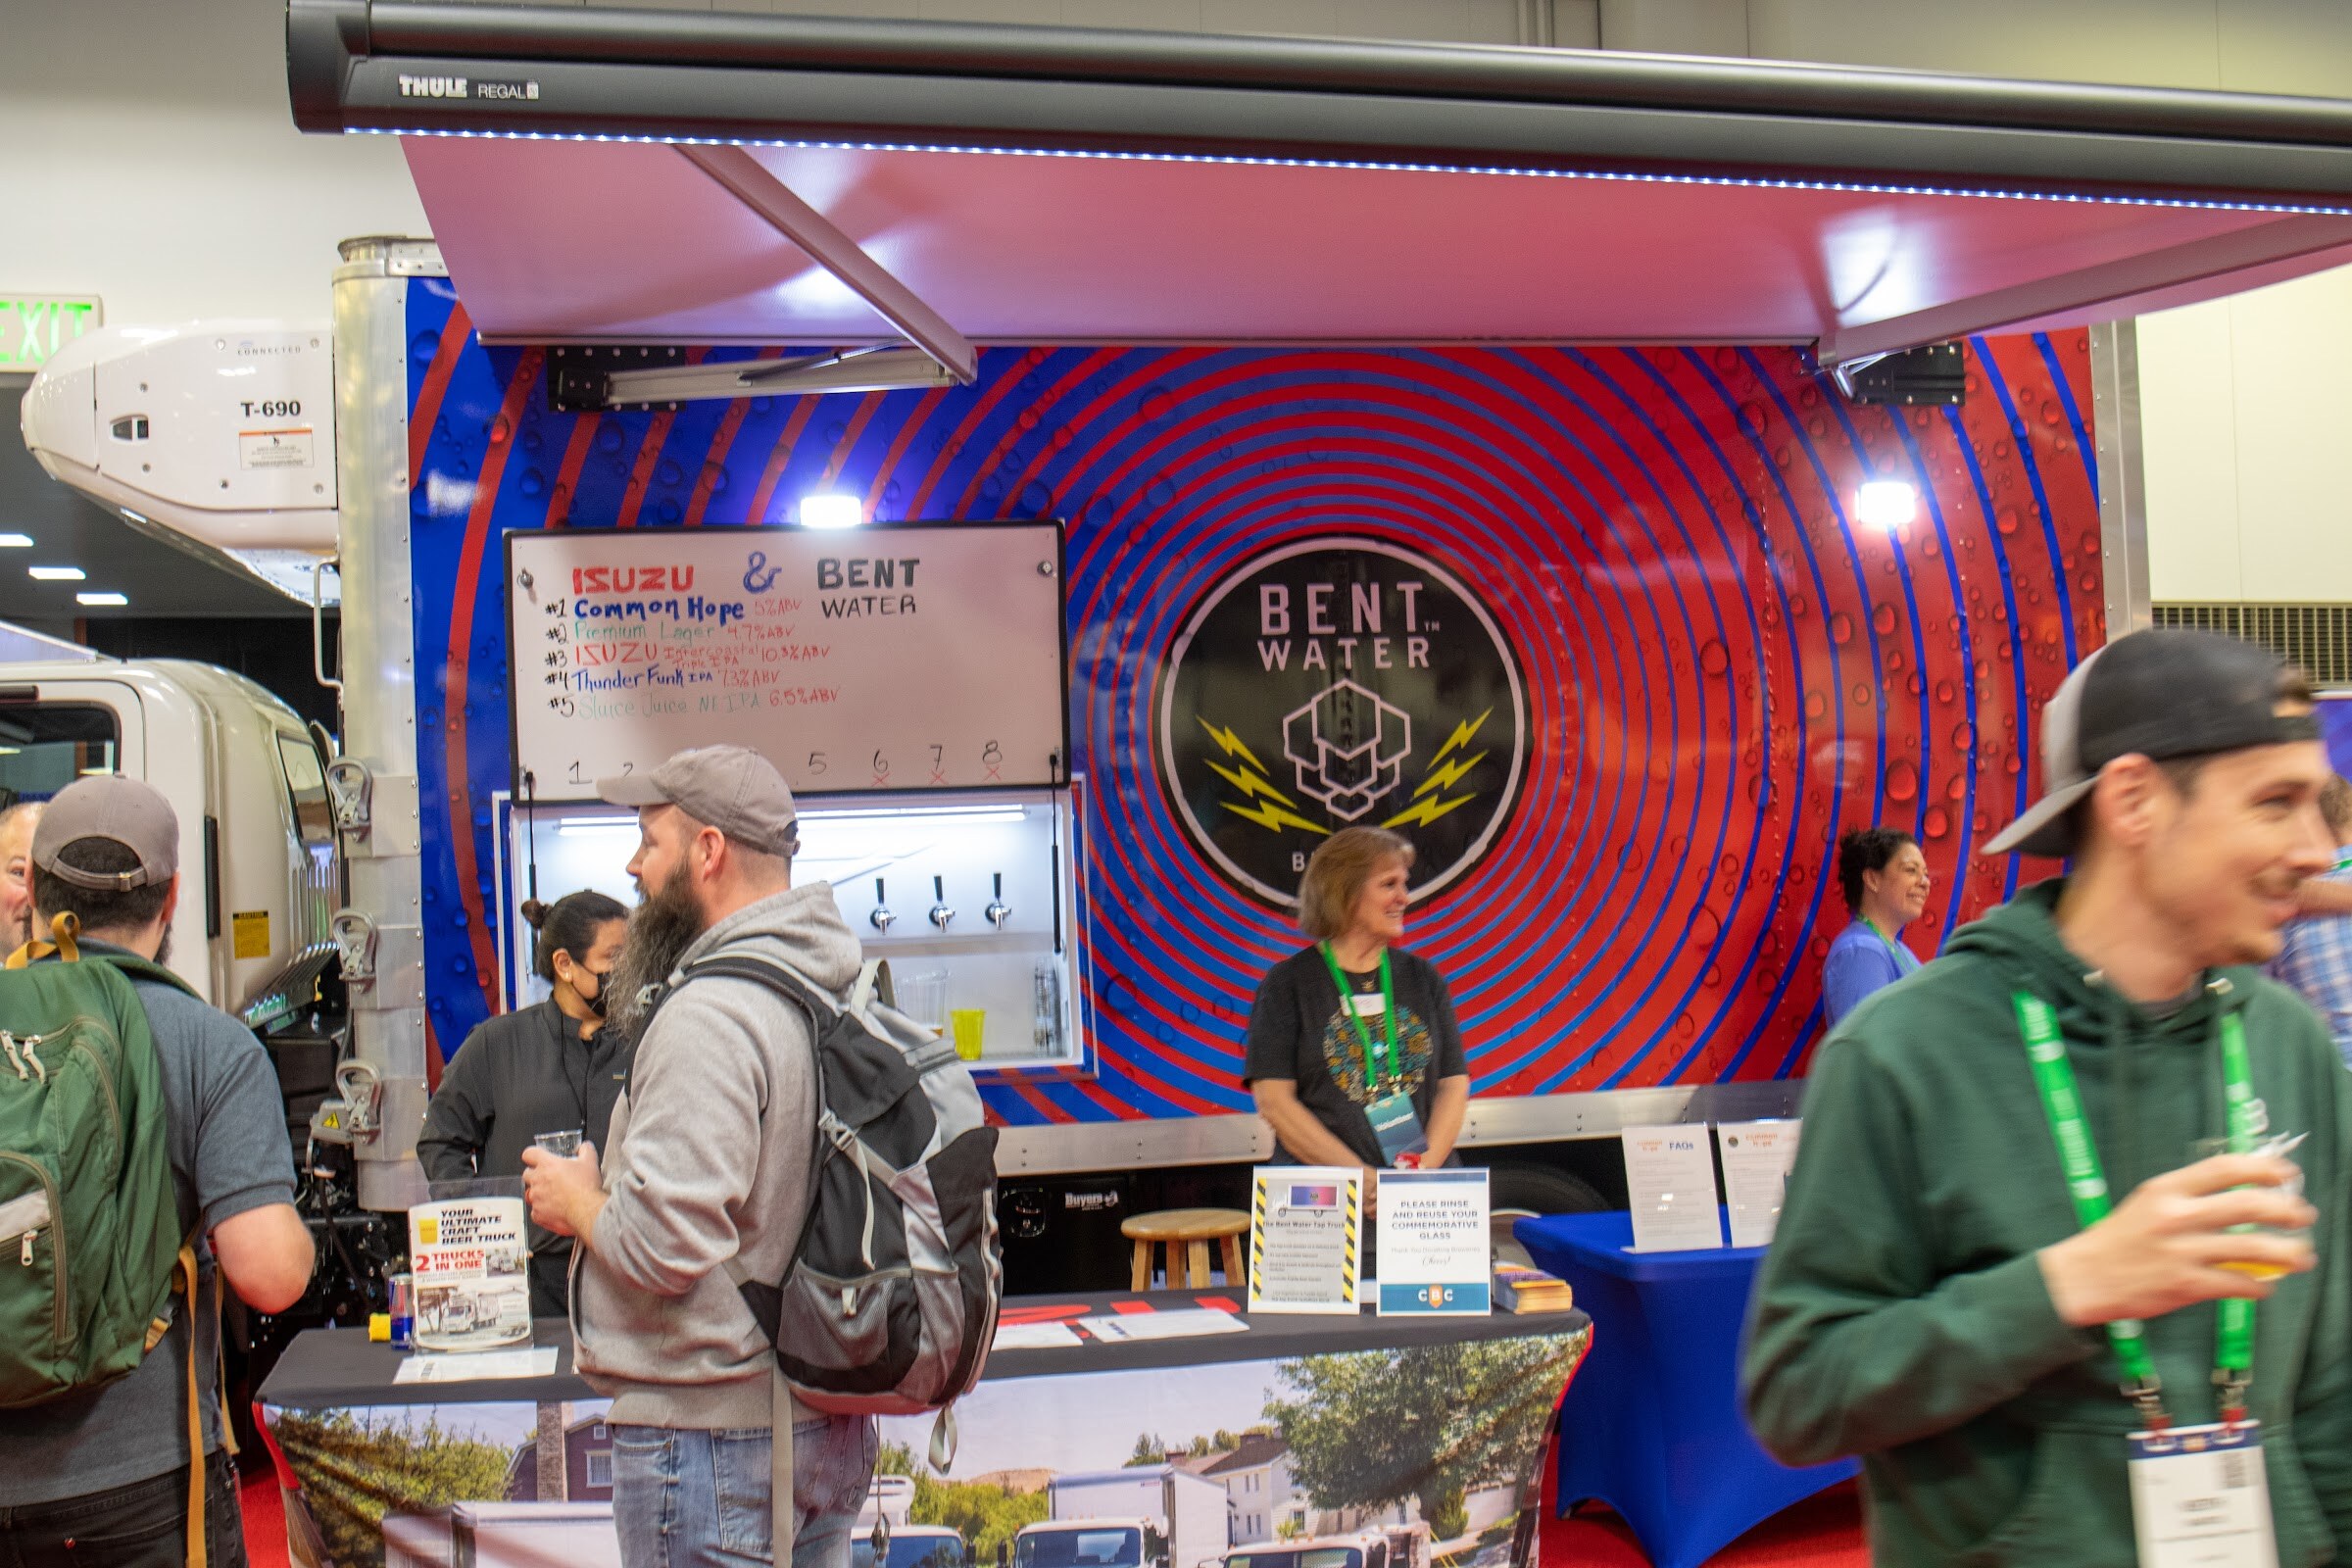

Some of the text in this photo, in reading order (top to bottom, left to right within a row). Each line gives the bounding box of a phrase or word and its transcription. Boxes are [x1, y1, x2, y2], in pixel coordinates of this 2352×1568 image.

[399, 74, 526, 99] THULE REGAL
[238, 346, 301, 356] CONNECTED
[241, 400, 301, 417] T-690
[573, 551, 920, 596] ISUZU & BENT
[545, 598, 566, 618] #1
[574, 598, 680, 621] Common
[687, 596, 745, 626] Hope
[821, 594, 916, 619] WATER
[1259, 580, 1423, 635] BENT
[545, 622, 569, 645] #2
[574, 620, 647, 640] Premium
[661, 621, 715, 647] Lager
[544, 650, 567, 668] #3
[575, 642, 658, 667] ISUZU
[1257, 637, 1430, 671] WATER
[544, 669, 568, 691] #4
[571, 666, 643, 693] Thunder
[647, 662, 685, 690] Funk
[688, 671, 713, 683] IPA
[547, 693, 574, 717] #5
[642, 691, 687, 717] Juice
[568, 760, 593, 784] 1
[808, 751, 827, 775] 5
[873, 749, 889, 773] 6
[930, 744, 943, 770] 7
[982, 739, 1003, 764] 8
[1669, 1141, 1693, 1151] FAQs
[1065, 1192, 1103, 1207] Buyers
[441, 1208, 473, 1217] YOUR
[441, 1215, 501, 1226] ULTIMATE
[441, 1227, 480, 1236] CRAFT
[1392, 1221, 1479, 1230] COMMEMORATIVE
[442, 1232, 515, 1246] BEER TRUCK
[416, 1250, 485, 1273] 2 TRUCKS
[435, 1259, 482, 1271] IN ONE
[1417, 1288, 1453, 1302] CBC
